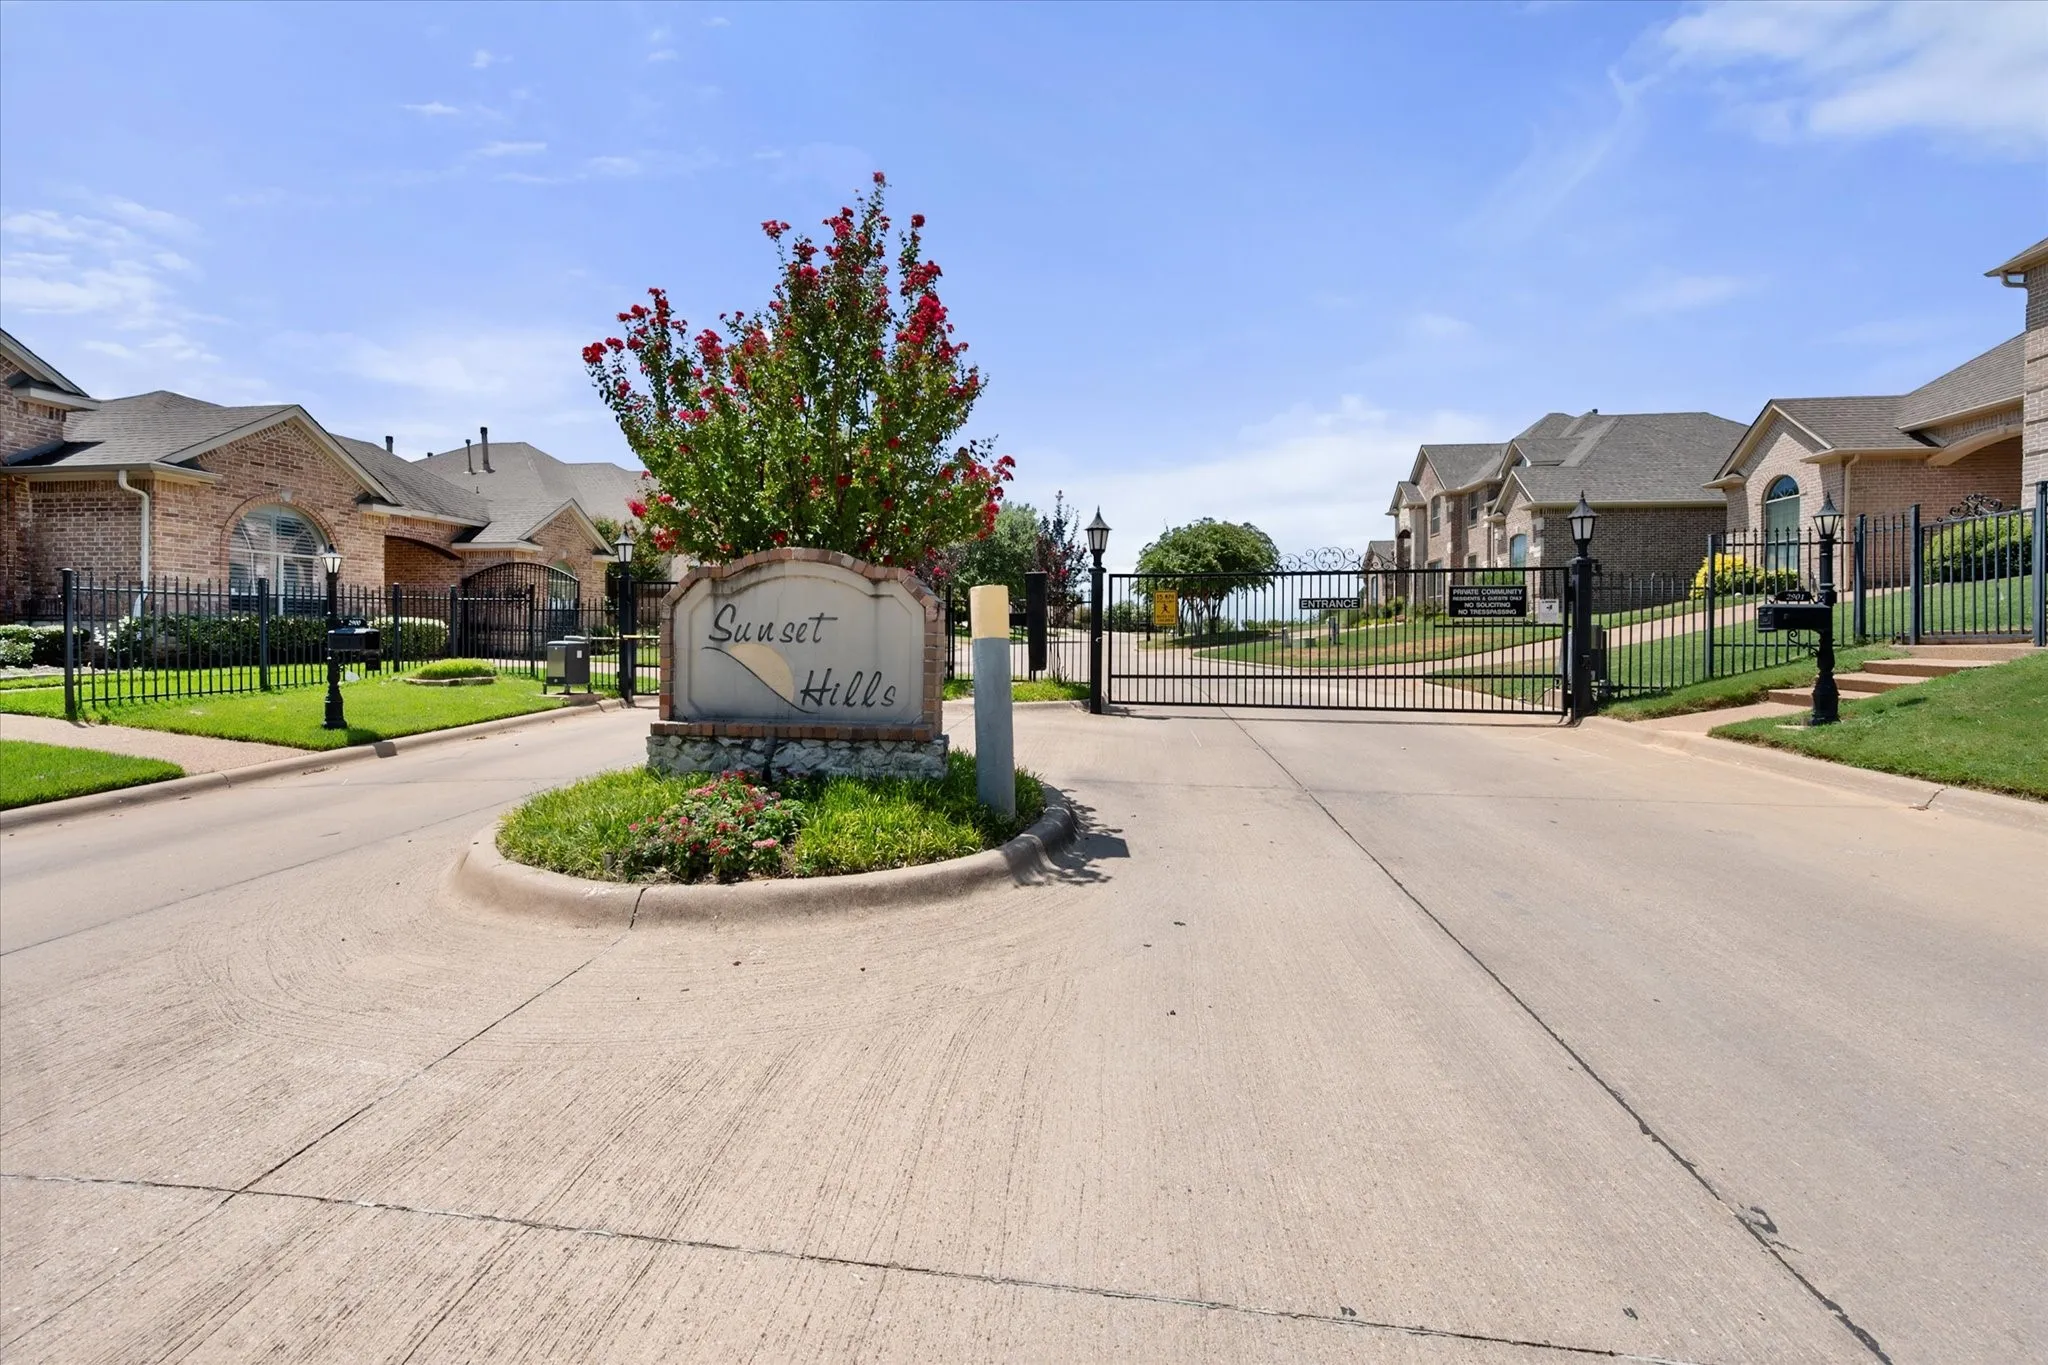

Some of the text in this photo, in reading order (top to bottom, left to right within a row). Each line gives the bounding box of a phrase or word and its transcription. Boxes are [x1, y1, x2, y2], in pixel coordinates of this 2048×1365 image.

[708, 603, 838, 644] Sunset
[1301, 600, 1358, 608] ENTRANCE
[800, 668, 896, 708] Hills
